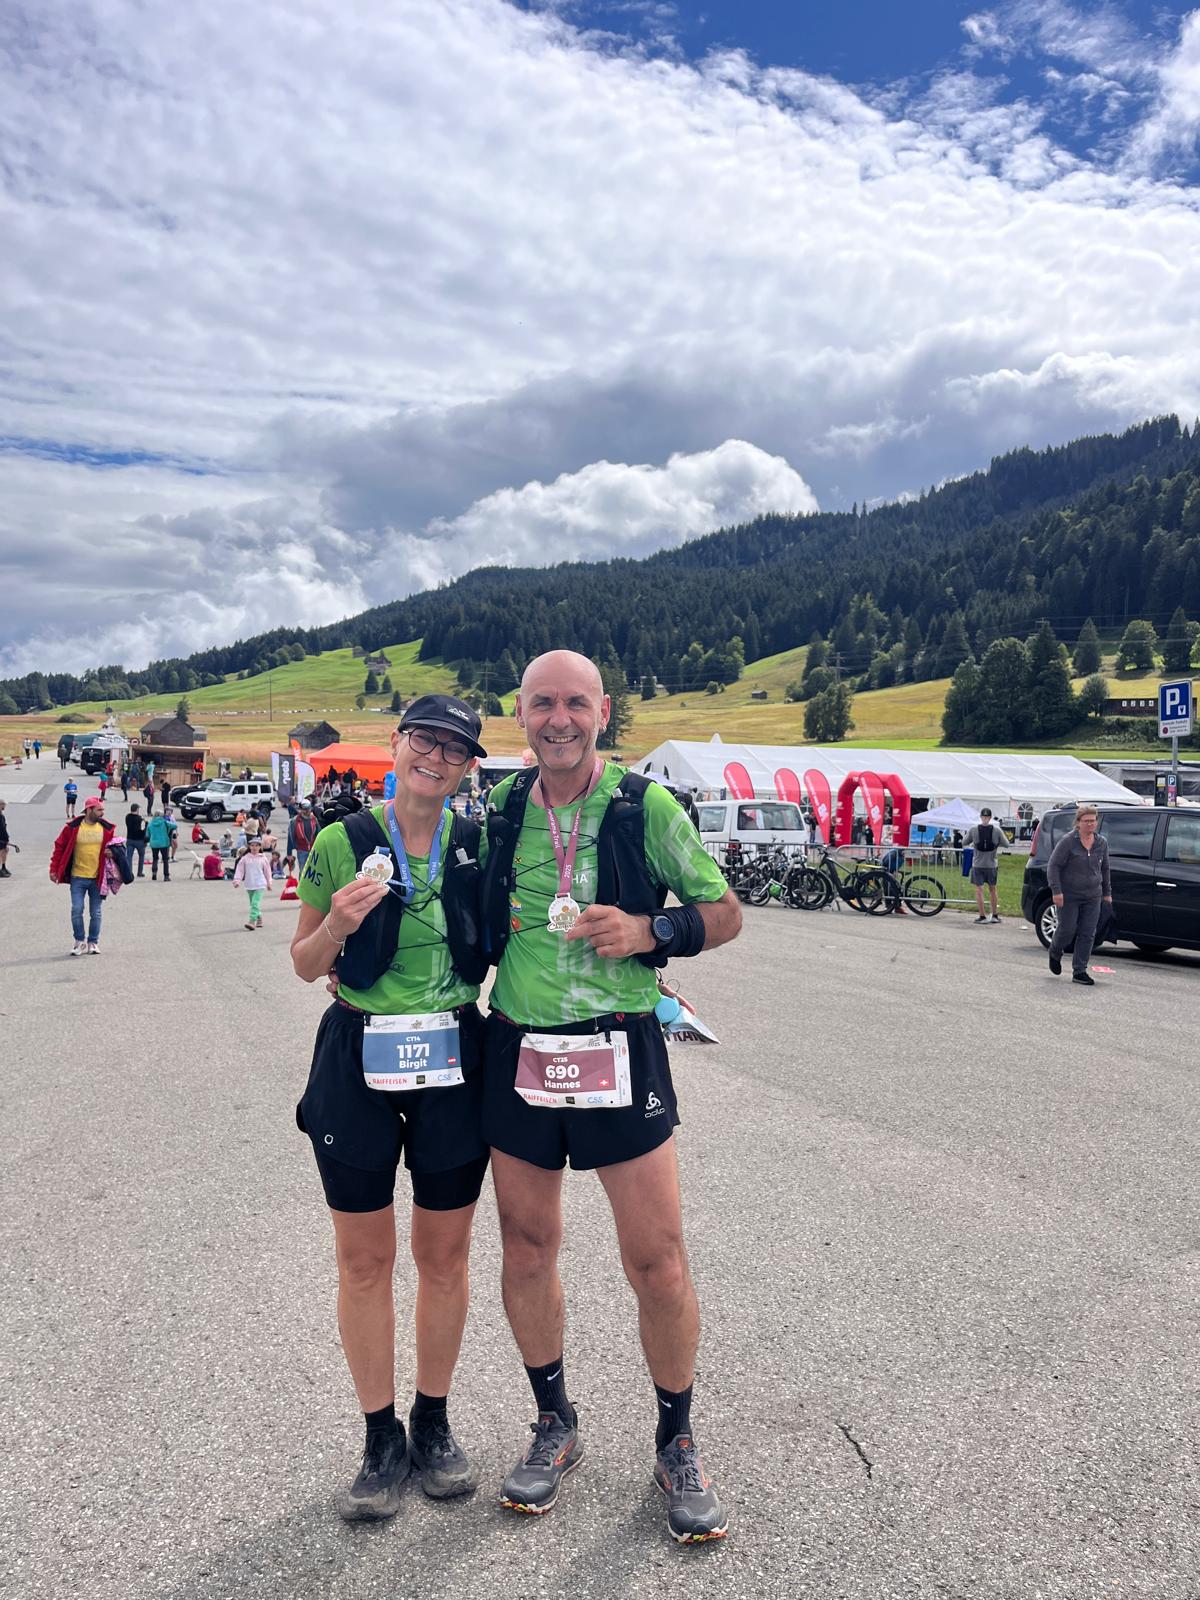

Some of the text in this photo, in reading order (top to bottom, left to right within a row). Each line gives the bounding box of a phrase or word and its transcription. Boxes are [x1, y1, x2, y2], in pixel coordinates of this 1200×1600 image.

[1166, 688, 1180, 715] P
[397, 1043, 430, 1059] 1171
[399, 1058, 428, 1070] Birgit
[437, 1073, 452, 1082] CSS
[545, 1063, 580, 1080] 690
[544, 1079, 581, 1089] Hannes
[523, 1093, 557, 1104] RAIFFEISEN
[587, 1096, 604, 1105] CSS
